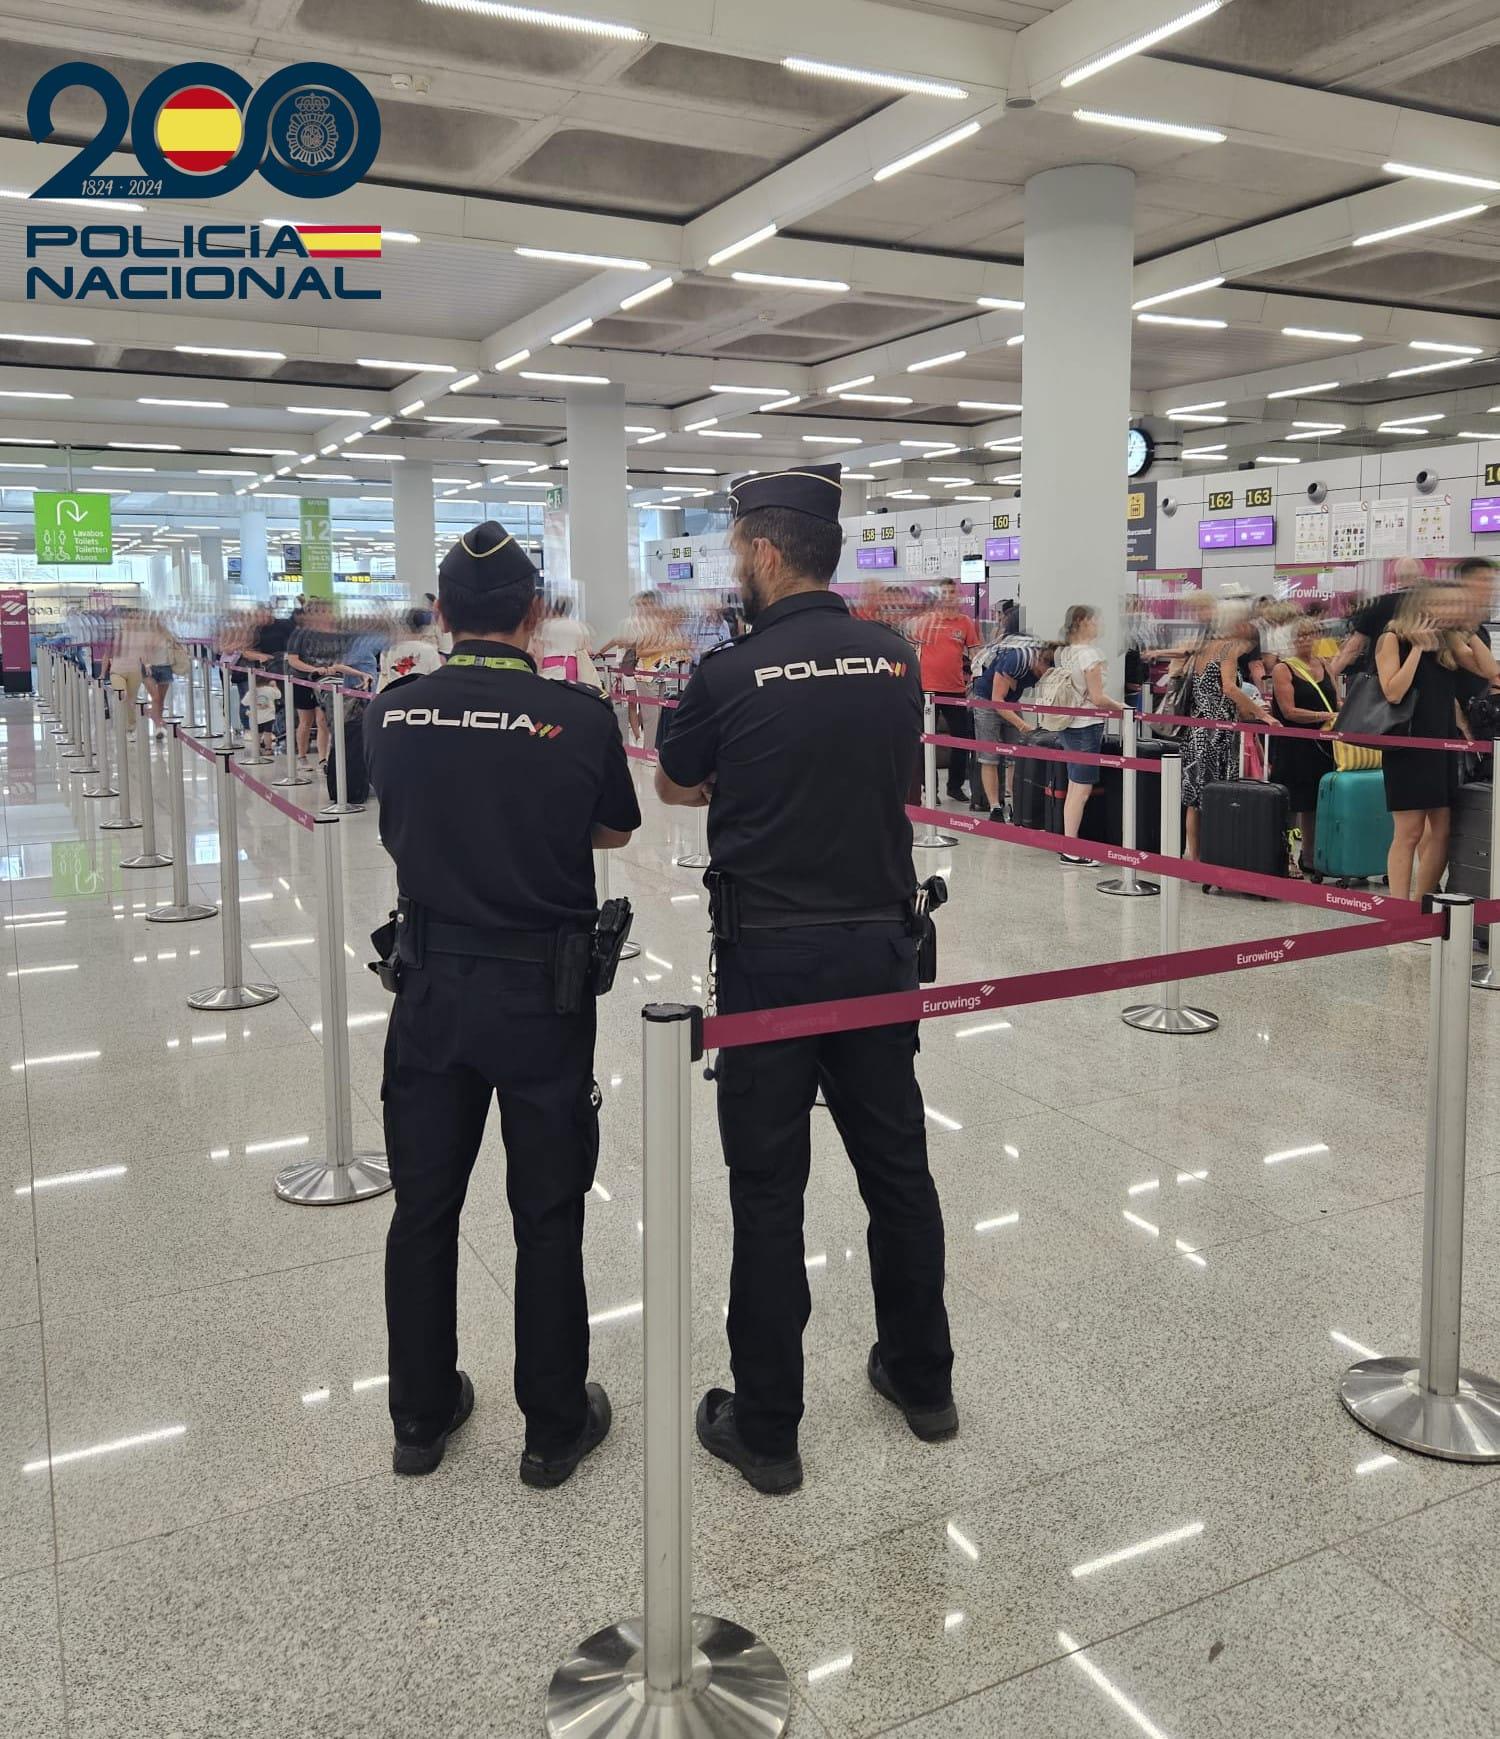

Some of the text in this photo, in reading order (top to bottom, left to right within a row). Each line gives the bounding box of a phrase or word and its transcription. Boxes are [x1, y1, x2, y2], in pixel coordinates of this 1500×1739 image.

[1209, 493, 1232, 509] 162
[1247, 489, 1270, 505] 163
[993, 515, 1009, 529] 160
[73, 529, 104, 537] Lavabos
[303, 519, 330, 541] 12
[862, 529, 875, 541] 158
[881, 527, 894, 539] 159
[75, 537, 99, 545] Toilets
[75, 545, 108, 553] Toiletten
[754, 656, 893, 688] POLICIA
[382, 708, 537, 733] POLICIA
[949, 817, 975, 831] Eurowings
[1107, 850, 1140, 865] Eurowings
[1326, 893, 1373, 912] Eurowings
[1236, 948, 1284, 965] Eurowings
[922, 994, 982, 1013] Eurowings
